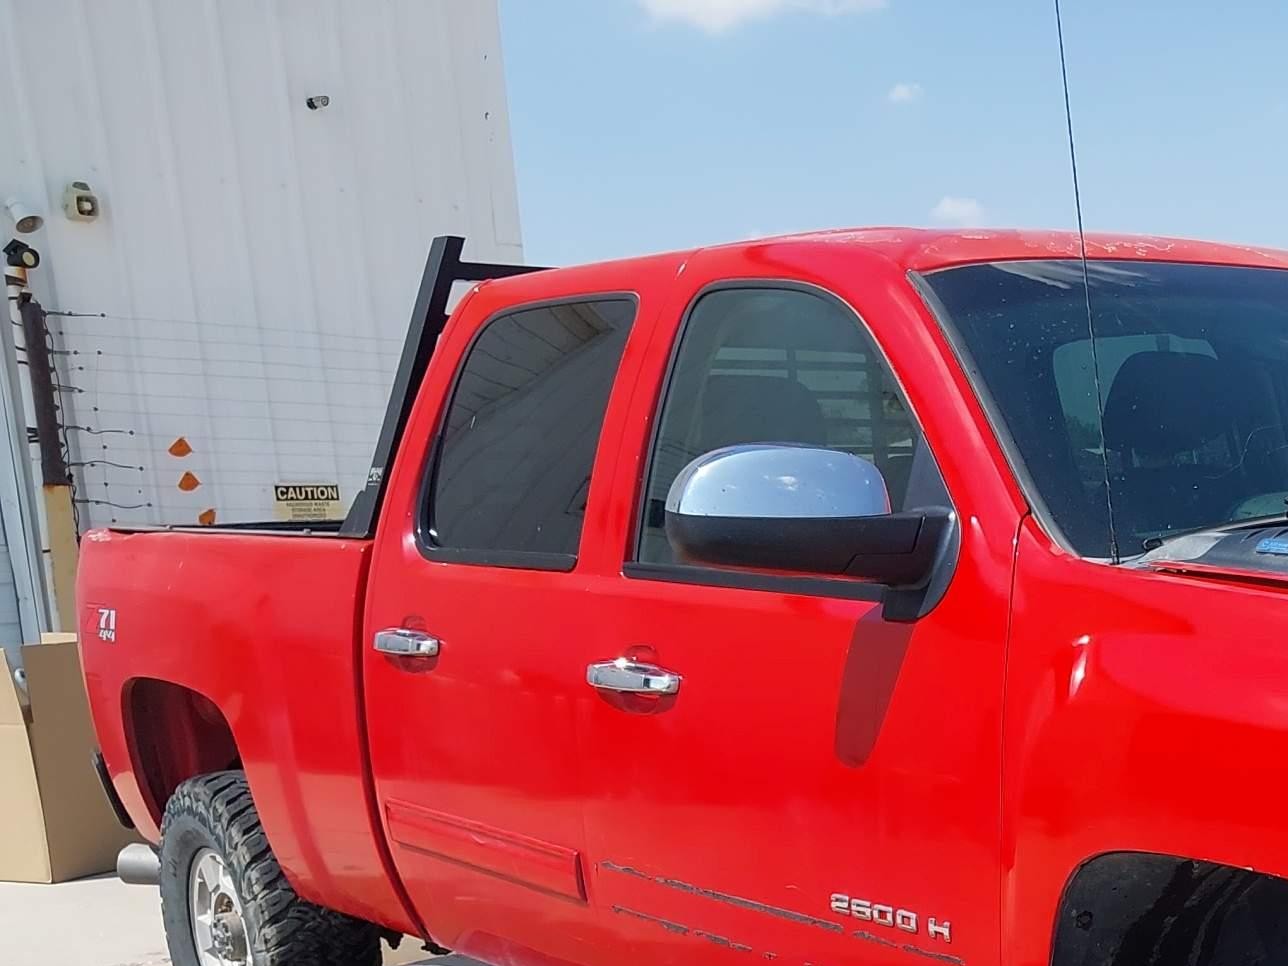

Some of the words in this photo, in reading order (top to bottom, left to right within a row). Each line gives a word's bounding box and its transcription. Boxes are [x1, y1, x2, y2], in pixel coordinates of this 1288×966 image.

[277, 487, 338, 500] CAUTION
[831, 893, 918, 932] 2500
[927, 917, 951, 943] H
